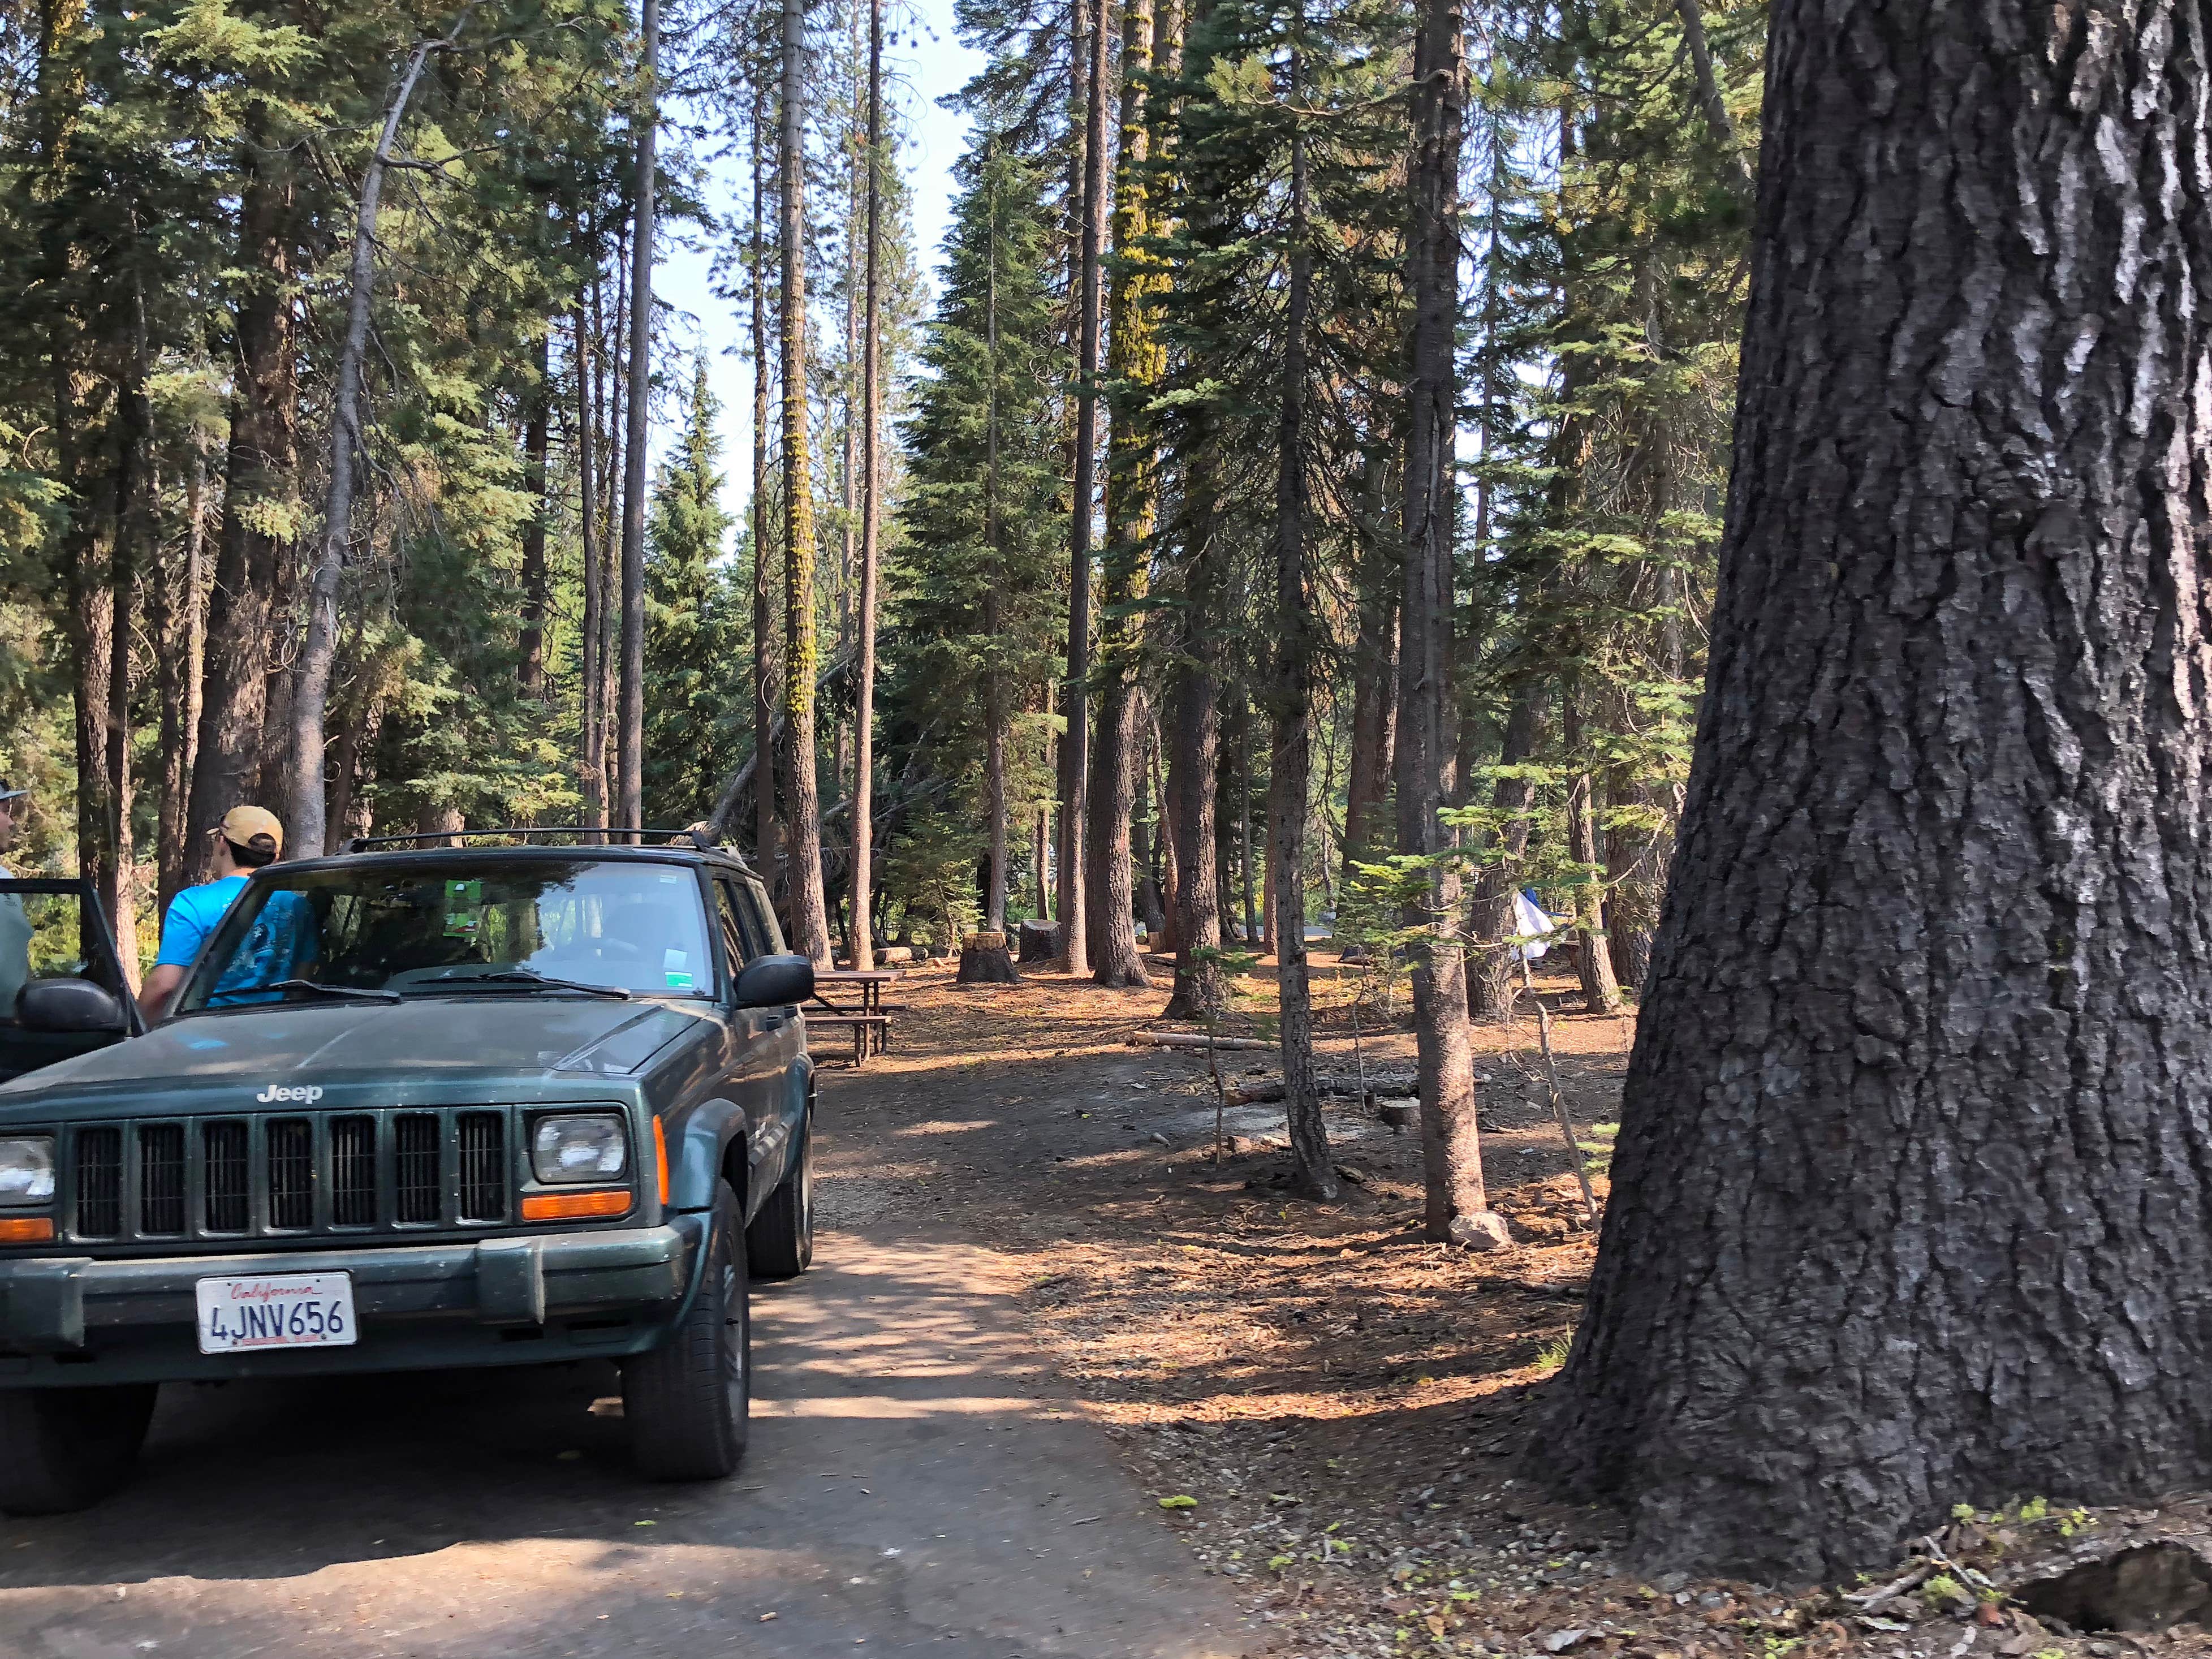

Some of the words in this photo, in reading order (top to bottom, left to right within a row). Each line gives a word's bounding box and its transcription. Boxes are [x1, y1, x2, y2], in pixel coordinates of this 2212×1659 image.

[256, 1084, 324, 1105] Jeep
[231, 1282, 323, 1302] California
[211, 1300, 344, 1341] 4JNV656
